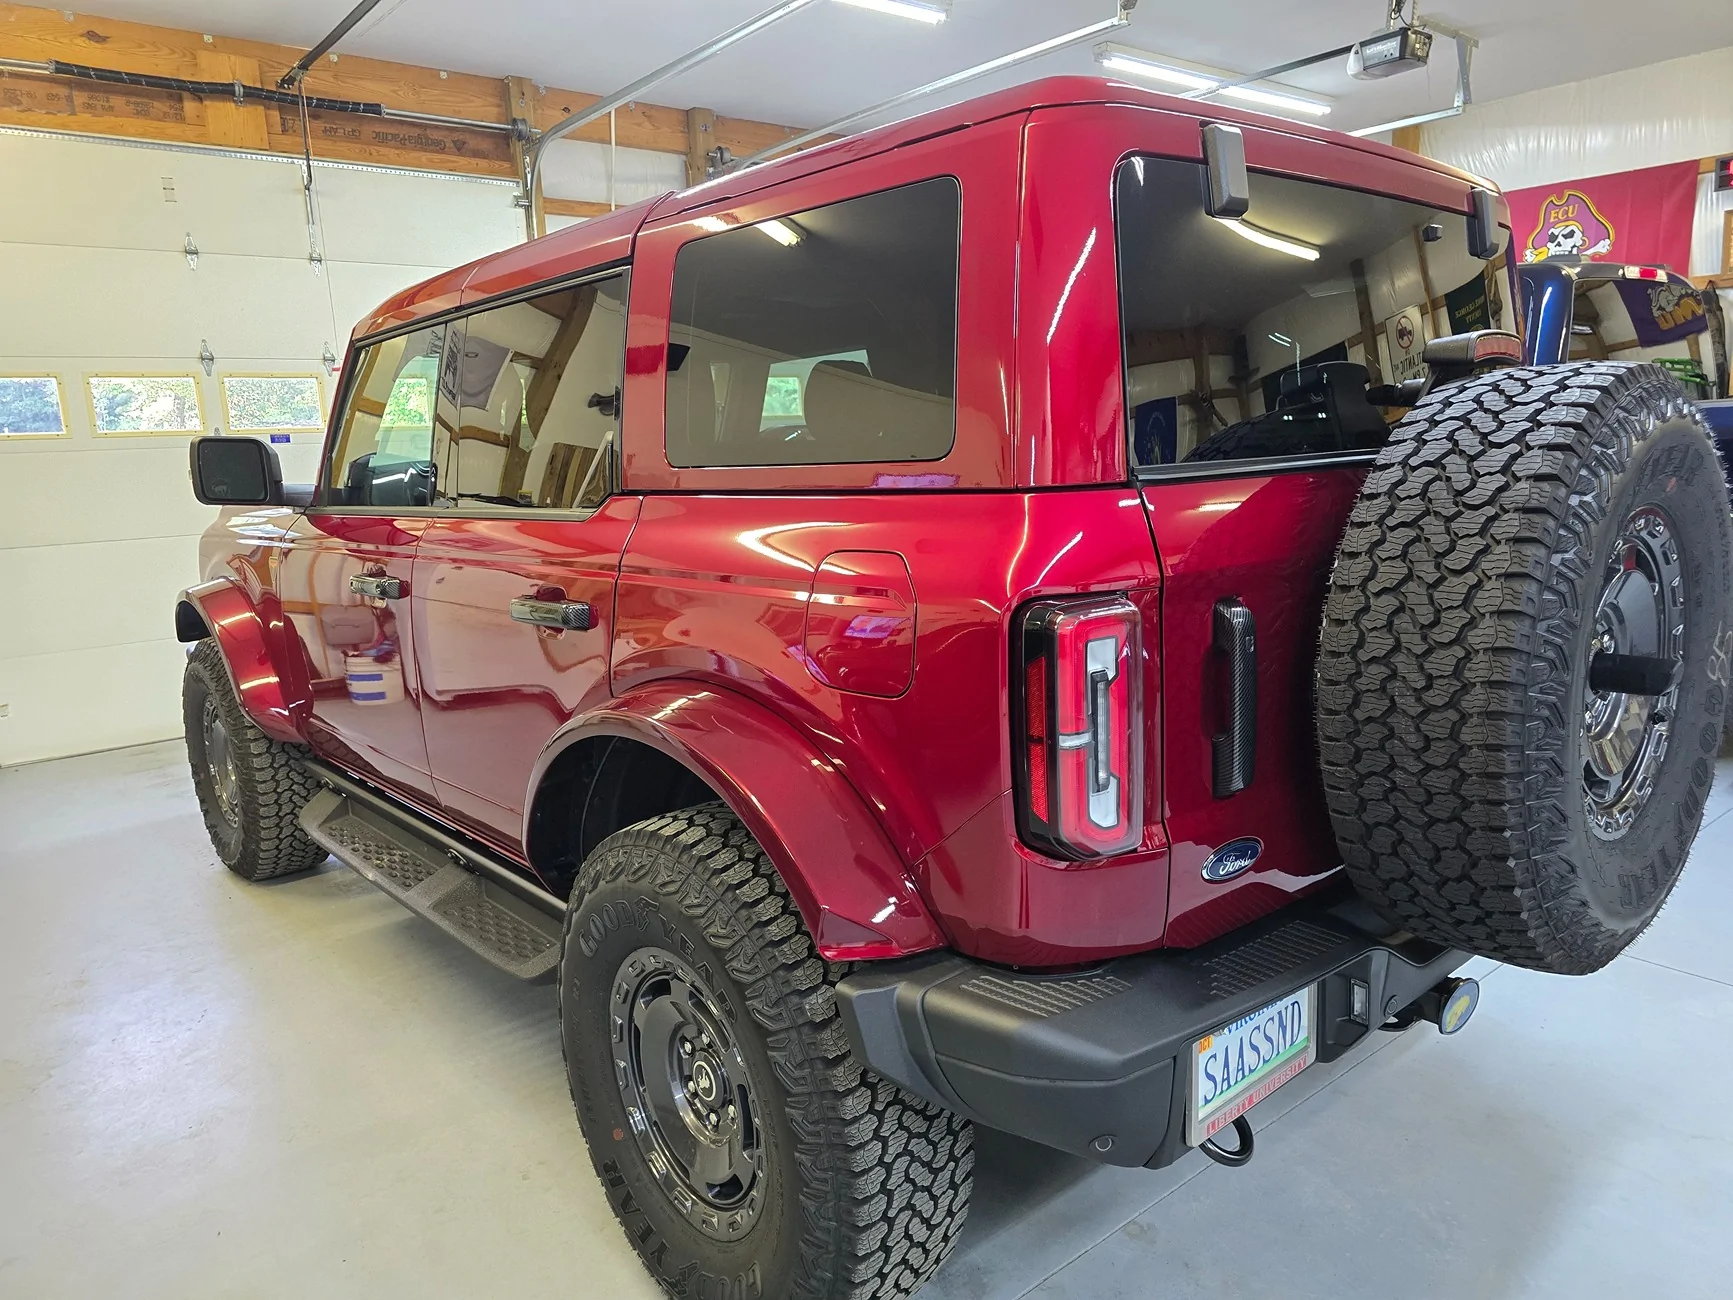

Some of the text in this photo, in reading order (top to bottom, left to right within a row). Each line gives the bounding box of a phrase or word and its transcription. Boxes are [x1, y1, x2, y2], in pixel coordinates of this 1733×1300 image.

[1549, 204, 1578, 222] ECU
[1219, 850, 1251, 875] Ford
[580, 896, 737, 1023] GOODYEAR
[1203, 1000, 1302, 1106] SAASSND
[1208, 1056, 1306, 1134] LIBERTY UNIVERSITY
